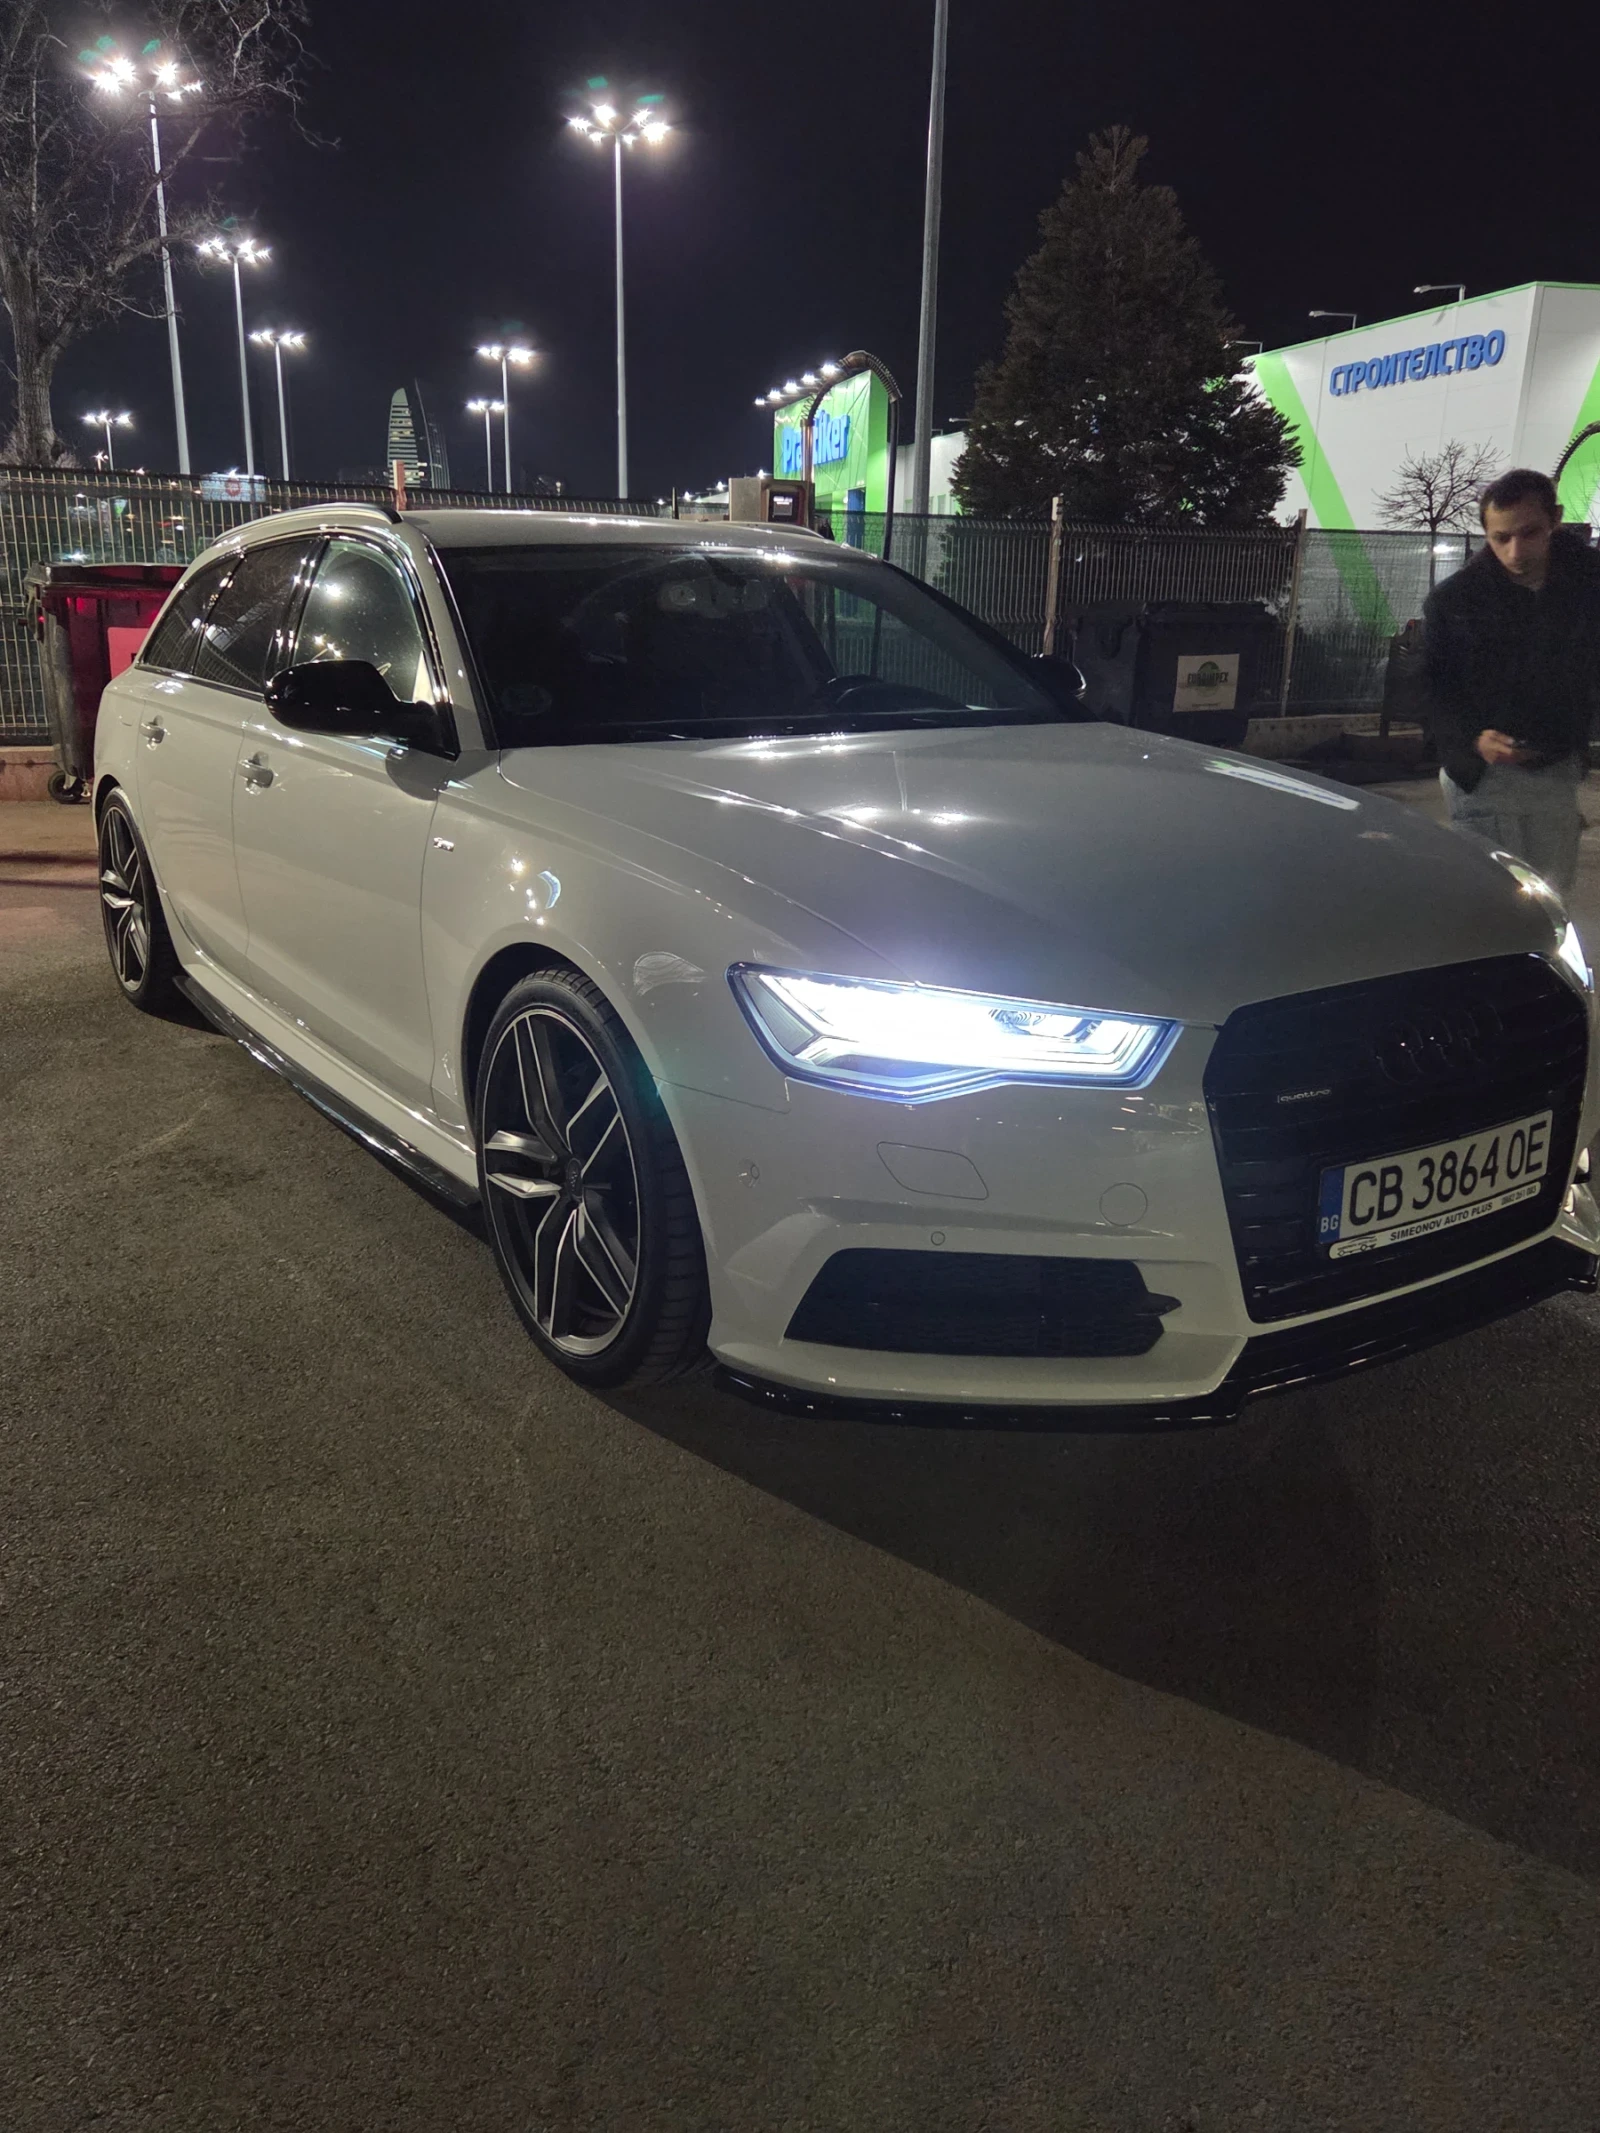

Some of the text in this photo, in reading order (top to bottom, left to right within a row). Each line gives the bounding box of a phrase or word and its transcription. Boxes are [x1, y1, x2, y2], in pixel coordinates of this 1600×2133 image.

[1329, 329, 1506, 396] СТРОИТЕЛСТВО
[782, 409, 850, 474] Pratiker
[1280, 1089, 1331, 1102] quattro
[1349, 1120, 1547, 1226] CB 3864 OE
[1320, 1214, 1340, 1233] BG
[1390, 1218, 1443, 1241] SIMEONOV
[1444, 1210, 1469, 1226] AUTO
[1471, 1202, 1493, 1217] PLUS
